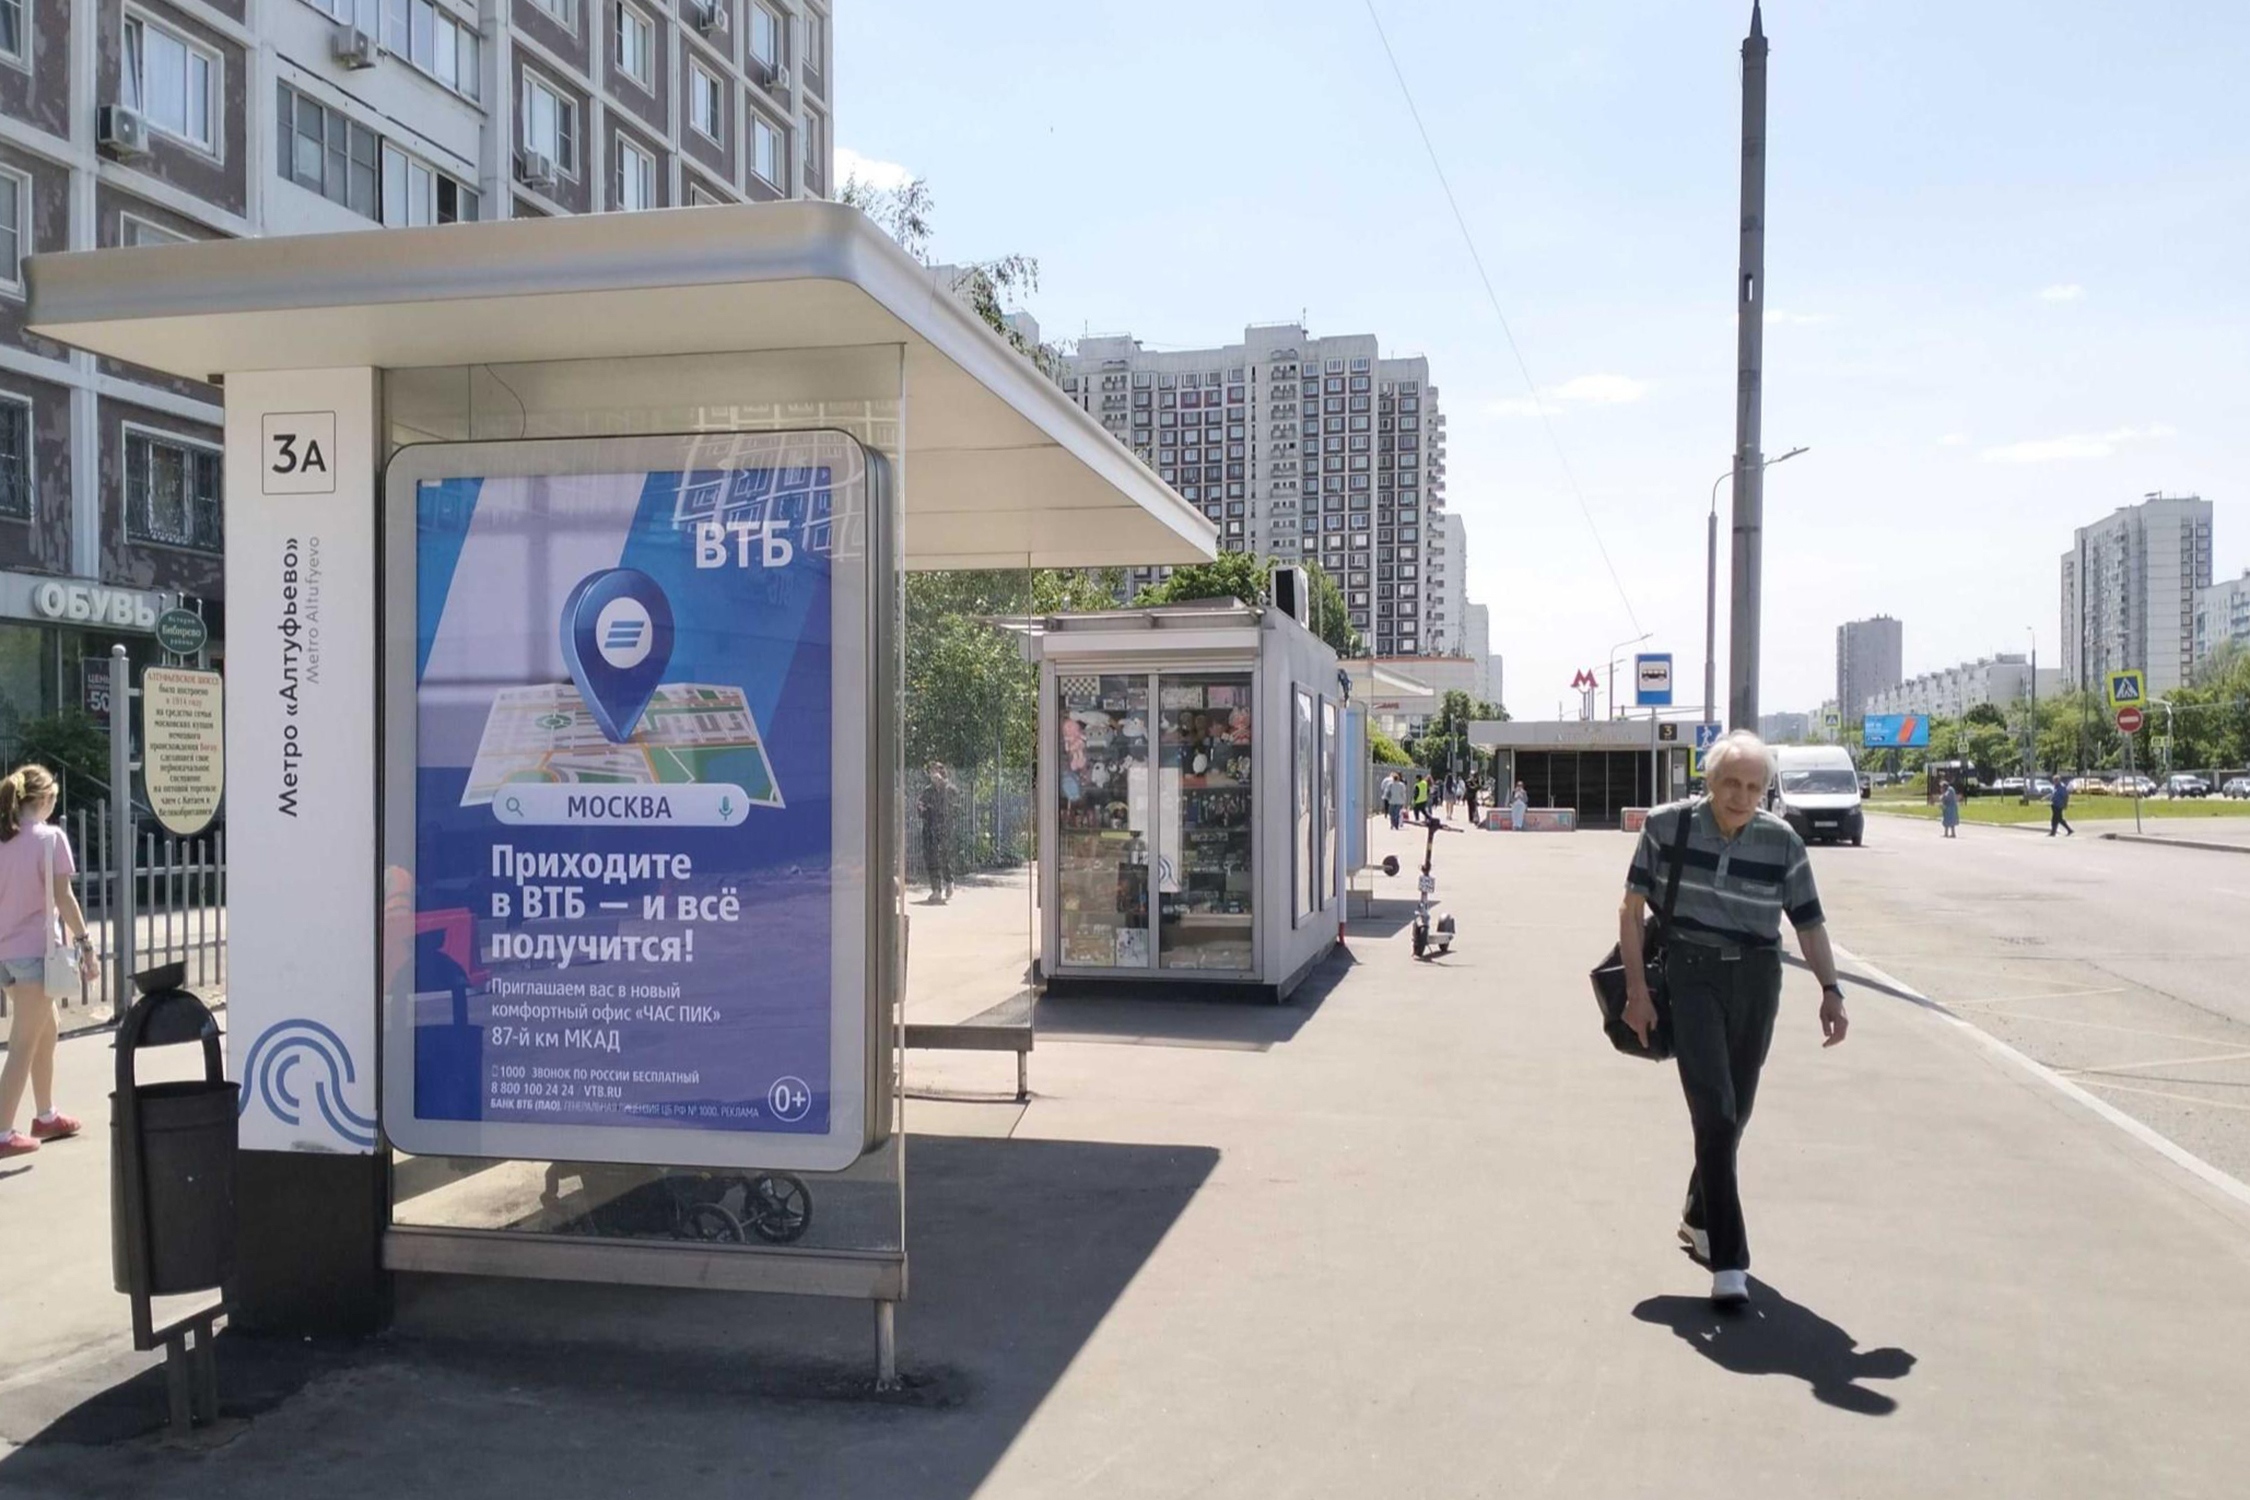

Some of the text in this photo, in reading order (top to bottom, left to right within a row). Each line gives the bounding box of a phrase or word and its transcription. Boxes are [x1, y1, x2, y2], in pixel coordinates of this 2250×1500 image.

[696, 520, 793, 569] ВТБ
[39, 582, 155, 627] ОБУВЬ
[304, 536, 322, 684] Metro Altufyevo
[277, 538, 303, 818] Метро «Алтуфьево»
[1663, 726, 1673, 737] 3
[566, 795, 673, 820] МОСКВА
[492, 844, 692, 886] Приходите
[492, 892, 511, 918] в
[522, 885, 586, 919] ВТБ
[643, 894, 665, 920] и
[677, 887, 740, 921] всё
[492, 929, 694, 970] получится!
[492, 977, 681, 999] Приглашаем вас в новый
[491, 1001, 721, 1024] комфортный офис «ЧАС ПИК»
[491, 1026, 621, 1053] 87-й км МКАД
[531, 1067, 571, 1079] ЗВОНОК
[573, 1068, 587, 1080] ПО
[590, 1070, 630, 1081] РОССИИ
[632, 1070, 700, 1084] БЕСПЛАТНЫЙ
[491, 1082, 622, 1098] 8 800 100 24 24 VTB.RU
[774, 1085, 806, 1113] 0+
[490, 1098, 514, 1109] БАНК
[516, 1099, 533, 1109] ВТБ
[721, 1107, 760, 1118] РЕКЛАМА
